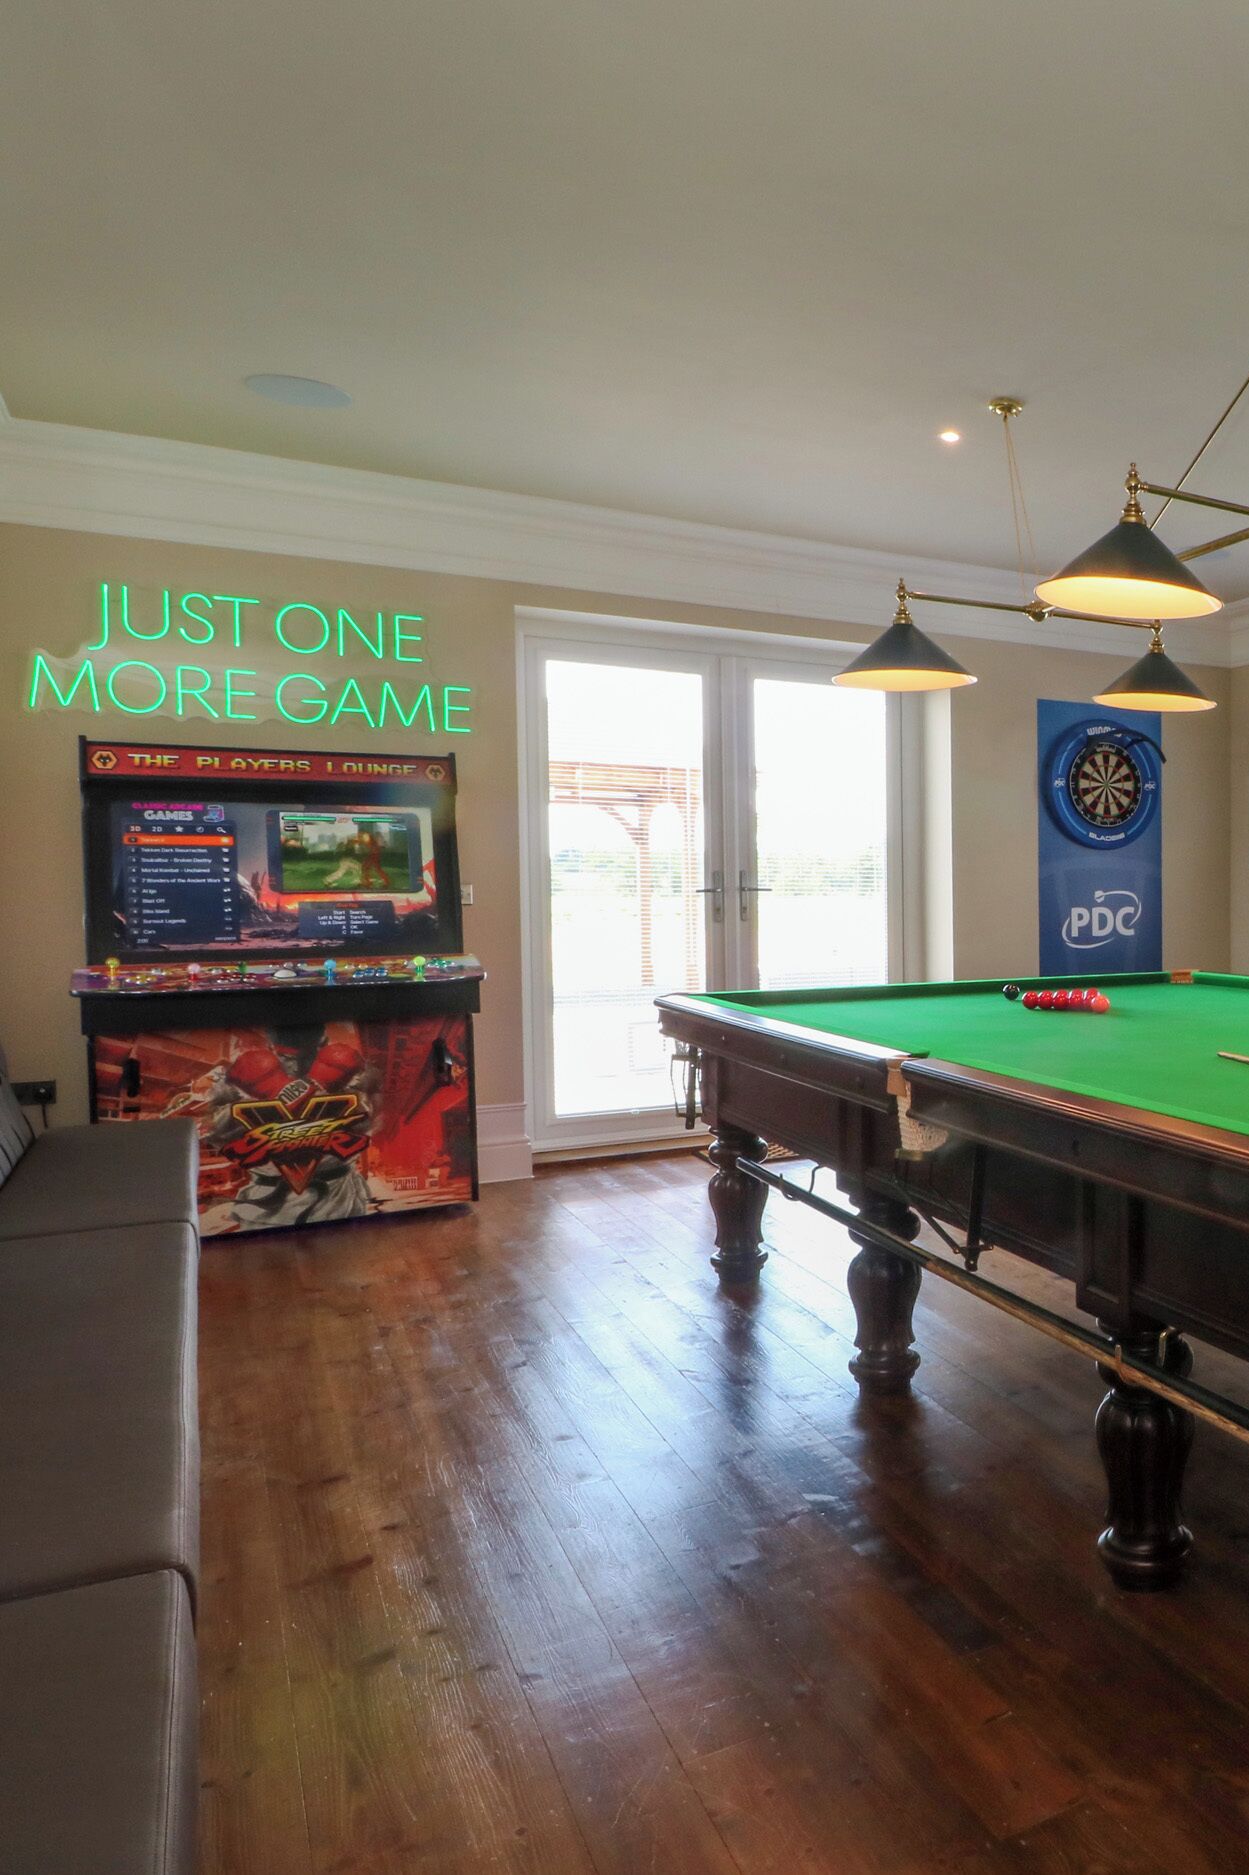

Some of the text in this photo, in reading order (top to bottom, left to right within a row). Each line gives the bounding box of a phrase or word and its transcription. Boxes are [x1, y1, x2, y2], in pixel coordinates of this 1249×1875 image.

[87, 583, 423, 663] JUST ONE
[30, 655, 472, 733] MORE GAME
[127, 753, 417, 777] THE PLAYERS LOUNGE
[144, 810, 194, 821] GAMES
[1071, 906, 1136, 938] PDC
[228, 1114, 365, 1154] STREET
[240, 1131, 370, 1163] FIGHTER
